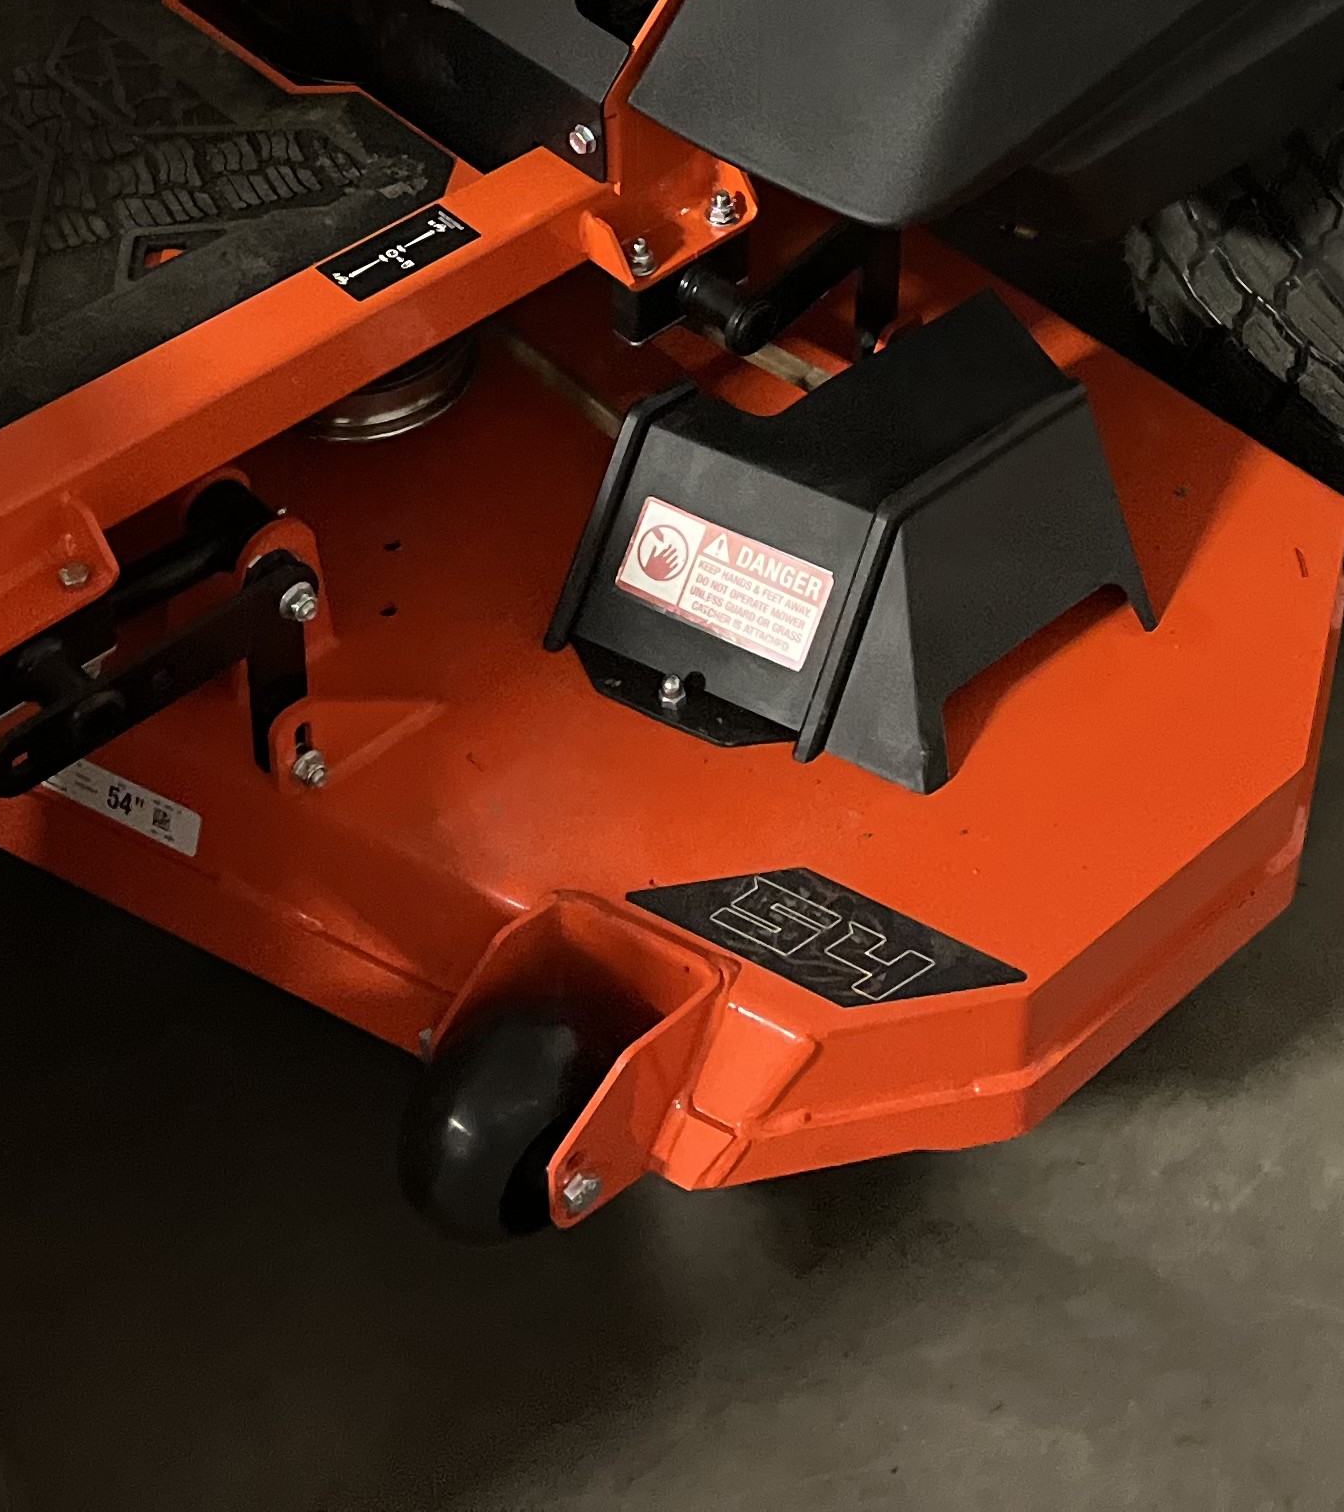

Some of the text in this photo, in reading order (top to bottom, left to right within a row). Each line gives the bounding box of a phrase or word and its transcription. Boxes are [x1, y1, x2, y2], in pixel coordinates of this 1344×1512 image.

[696, 573, 806, 629] DO NOT OPERATE MOWER
[698, 559, 721, 575] KEEP
[721, 569, 752, 591] HANDS
[753, 584, 760, 595] &
[761, 588, 784, 605] FEET
[736, 545, 823, 601] DANGER
[690, 585, 803, 644] UNLESS GUARD OR GRASS
[691, 600, 732, 624] CATCHER
[732, 618, 741, 631] IS
[709, 875, 936, 1001] 54
